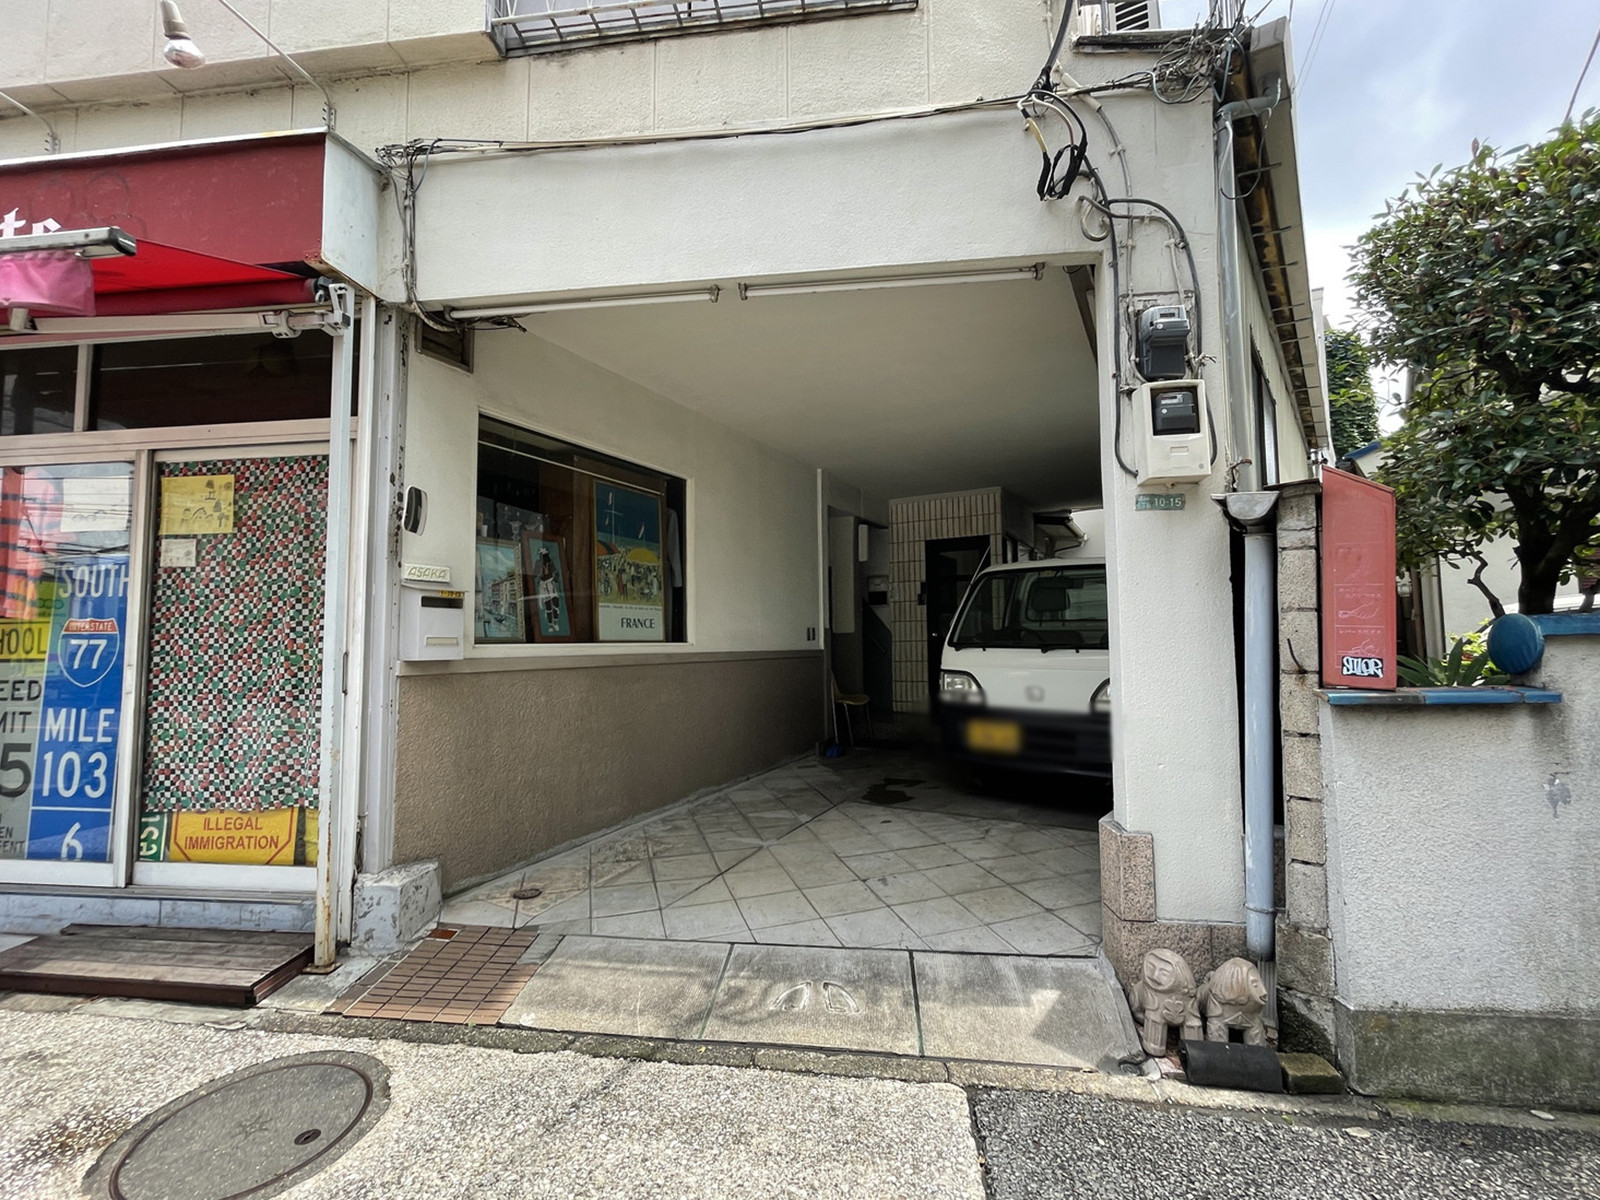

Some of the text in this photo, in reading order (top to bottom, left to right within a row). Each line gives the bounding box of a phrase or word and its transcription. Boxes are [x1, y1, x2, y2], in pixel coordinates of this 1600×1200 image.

[58, 563, 129, 598] SOUTH
[69, 621, 113, 631] INTERSTATE
[620, 617, 656, 629] FRANCE
[70, 639, 108, 670] 77
[44, 707, 115, 742] MILE
[42, 751, 108, 798] 103
[203, 817, 263, 831] ILLEGAL
[60, 821, 83, 861] 6
[184, 835, 279, 850] IMMIGRATION
